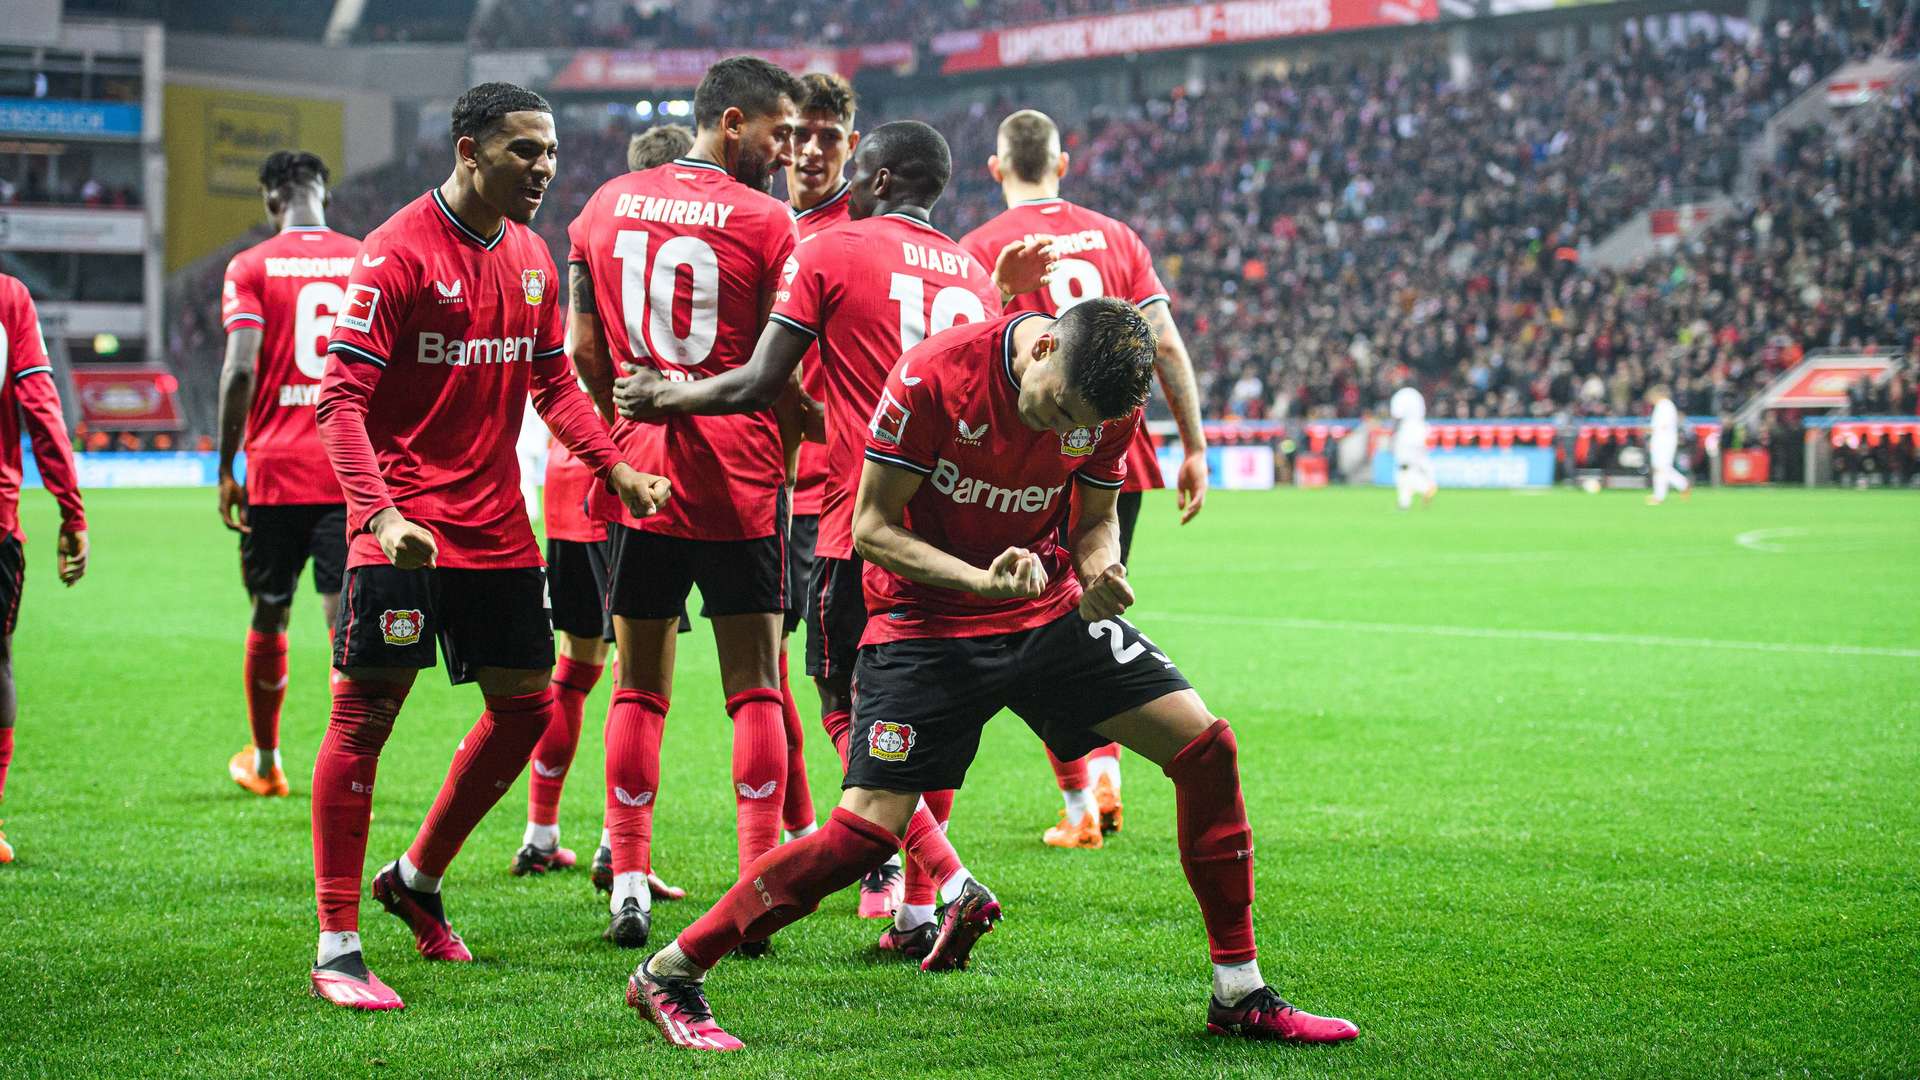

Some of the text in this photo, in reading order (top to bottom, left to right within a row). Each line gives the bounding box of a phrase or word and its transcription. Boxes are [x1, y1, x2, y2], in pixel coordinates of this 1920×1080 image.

[614, 193, 734, 228] DEMIRBAY
[902, 242, 970, 279] DIABY
[294, 281, 345, 380] 6
[613, 230, 719, 366] 10
